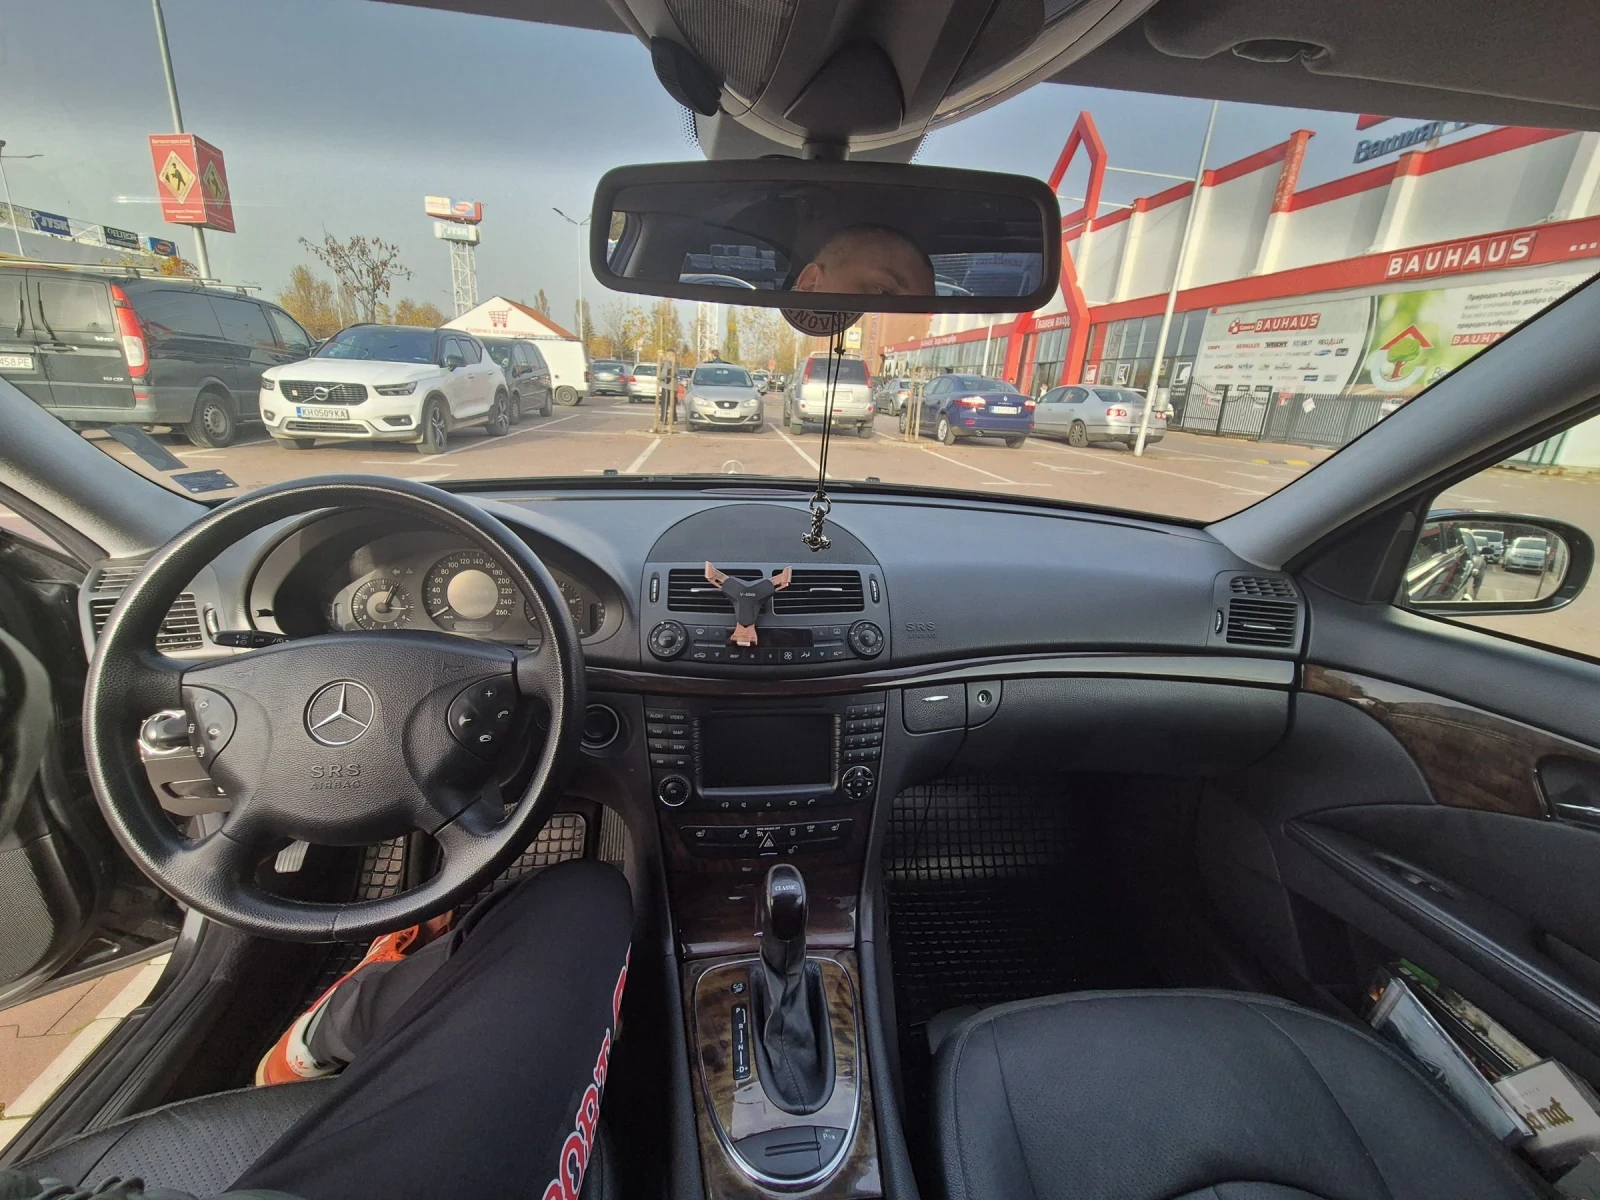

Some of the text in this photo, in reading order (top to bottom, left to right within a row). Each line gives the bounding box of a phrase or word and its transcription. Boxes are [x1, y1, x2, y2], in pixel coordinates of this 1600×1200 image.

[40, 216, 70, 231] JYSK
[1386, 233, 1532, 277] BAUHAUS
[1055, 314, 1070, 328] вход
[1255, 314, 1320, 332] BAUHAUS
[1451, 333, 1502, 345] BAUHA
[906, 621, 936, 631] SRS
[310, 764, 360, 778] SRS
